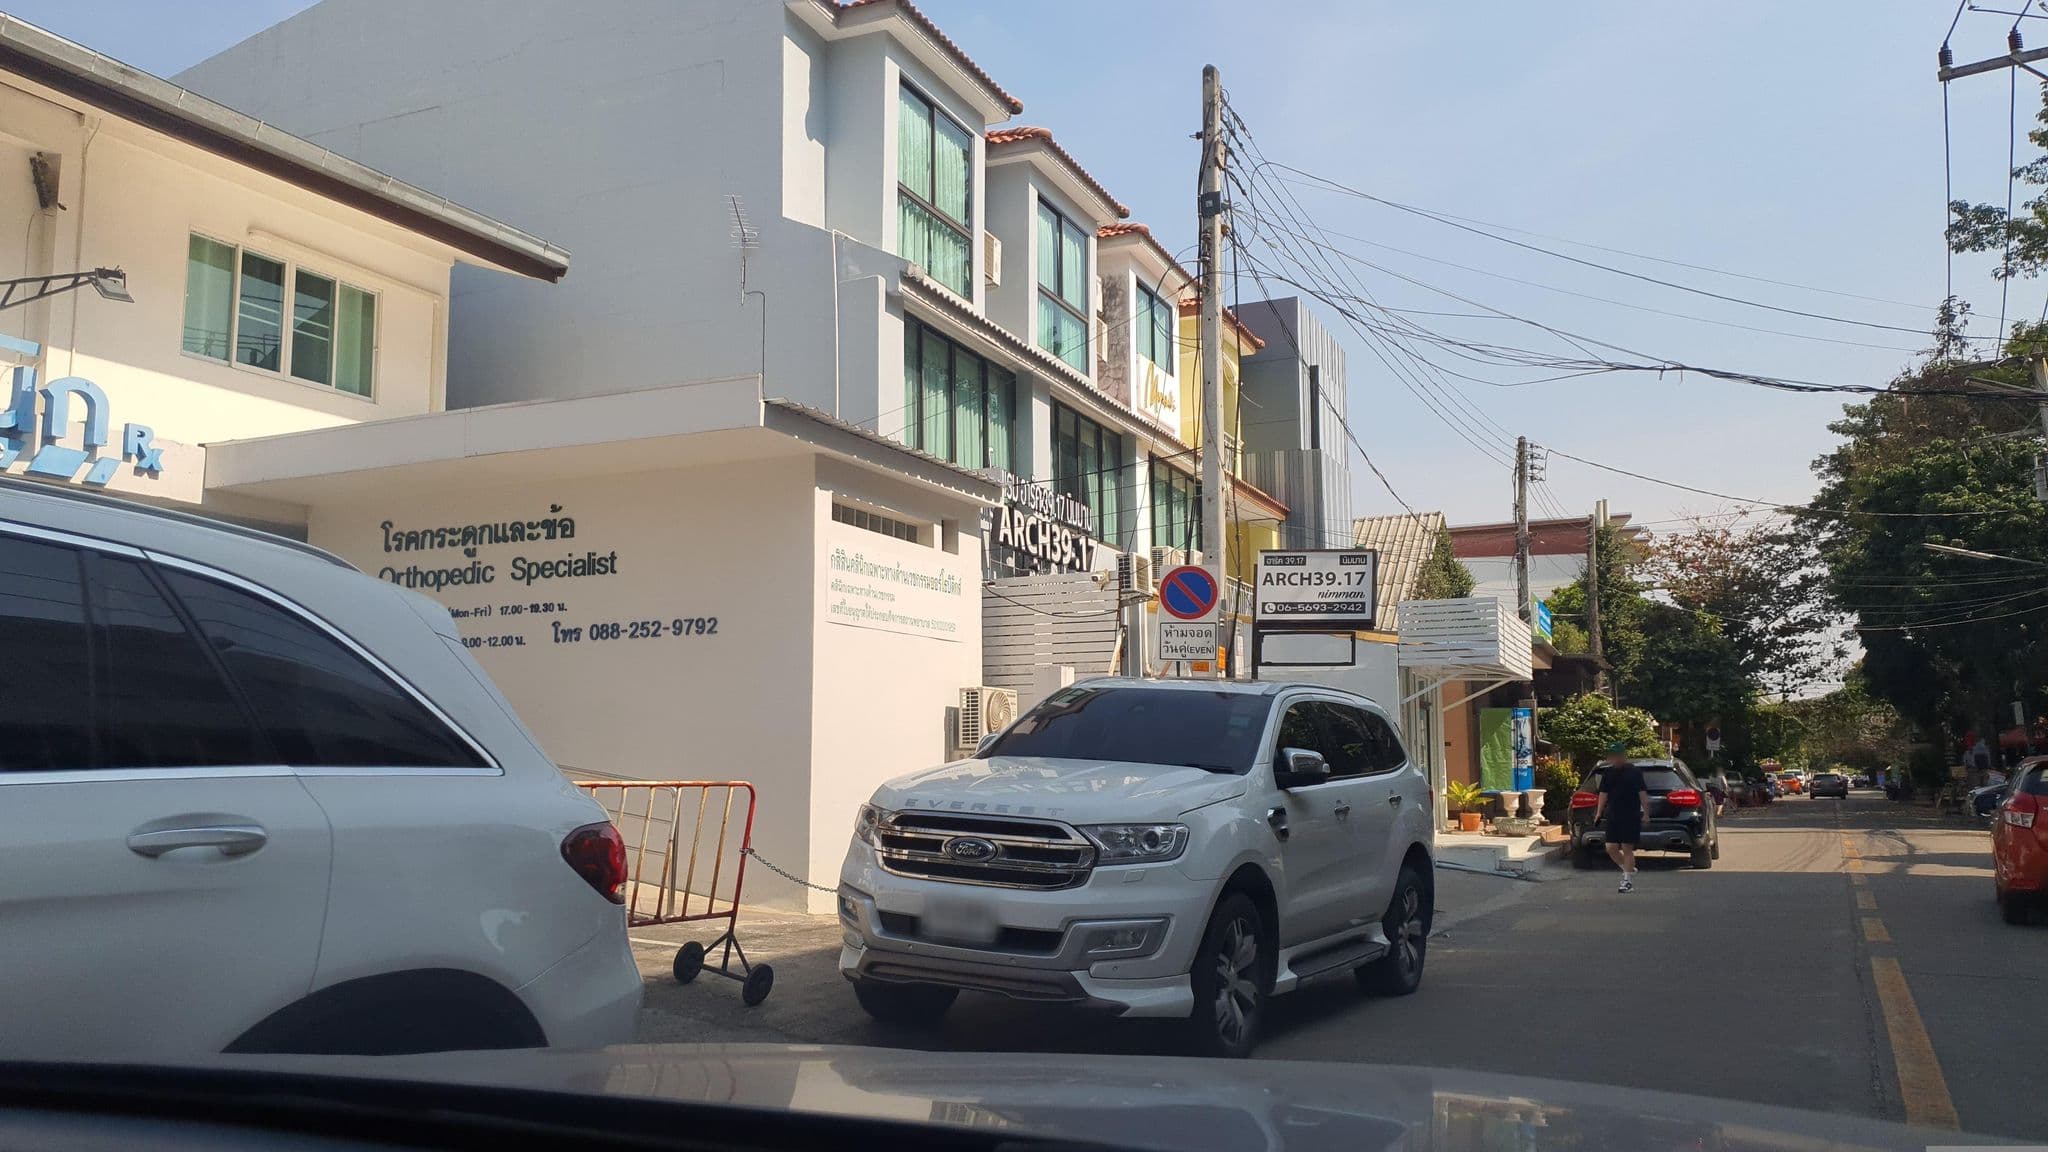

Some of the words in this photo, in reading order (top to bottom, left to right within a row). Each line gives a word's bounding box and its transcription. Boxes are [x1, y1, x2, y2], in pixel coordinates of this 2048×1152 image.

[380, 504, 576, 558] โรคกระดูกและข้อ
[999, 506, 1098, 573] ARCH39.17
[1285, 557, 1304, 565] 39.17
[379, 561, 495, 592] Orthopedic
[510, 551, 617, 585] Specialist
[1262, 571, 1366, 586] ARCH39.17
[1317, 589, 1366, 599] nimman
[500, 602, 554, 616] 17.00-19.30
[1277, 603, 1362, 612] 06-5693-2942
[552, 621, 582, 644] โทร
[589, 617, 718, 641] 088-252-9792
[1164, 625, 1212, 638] ห้ามจอด
[905, 798, 1065, 816] EVEREST
